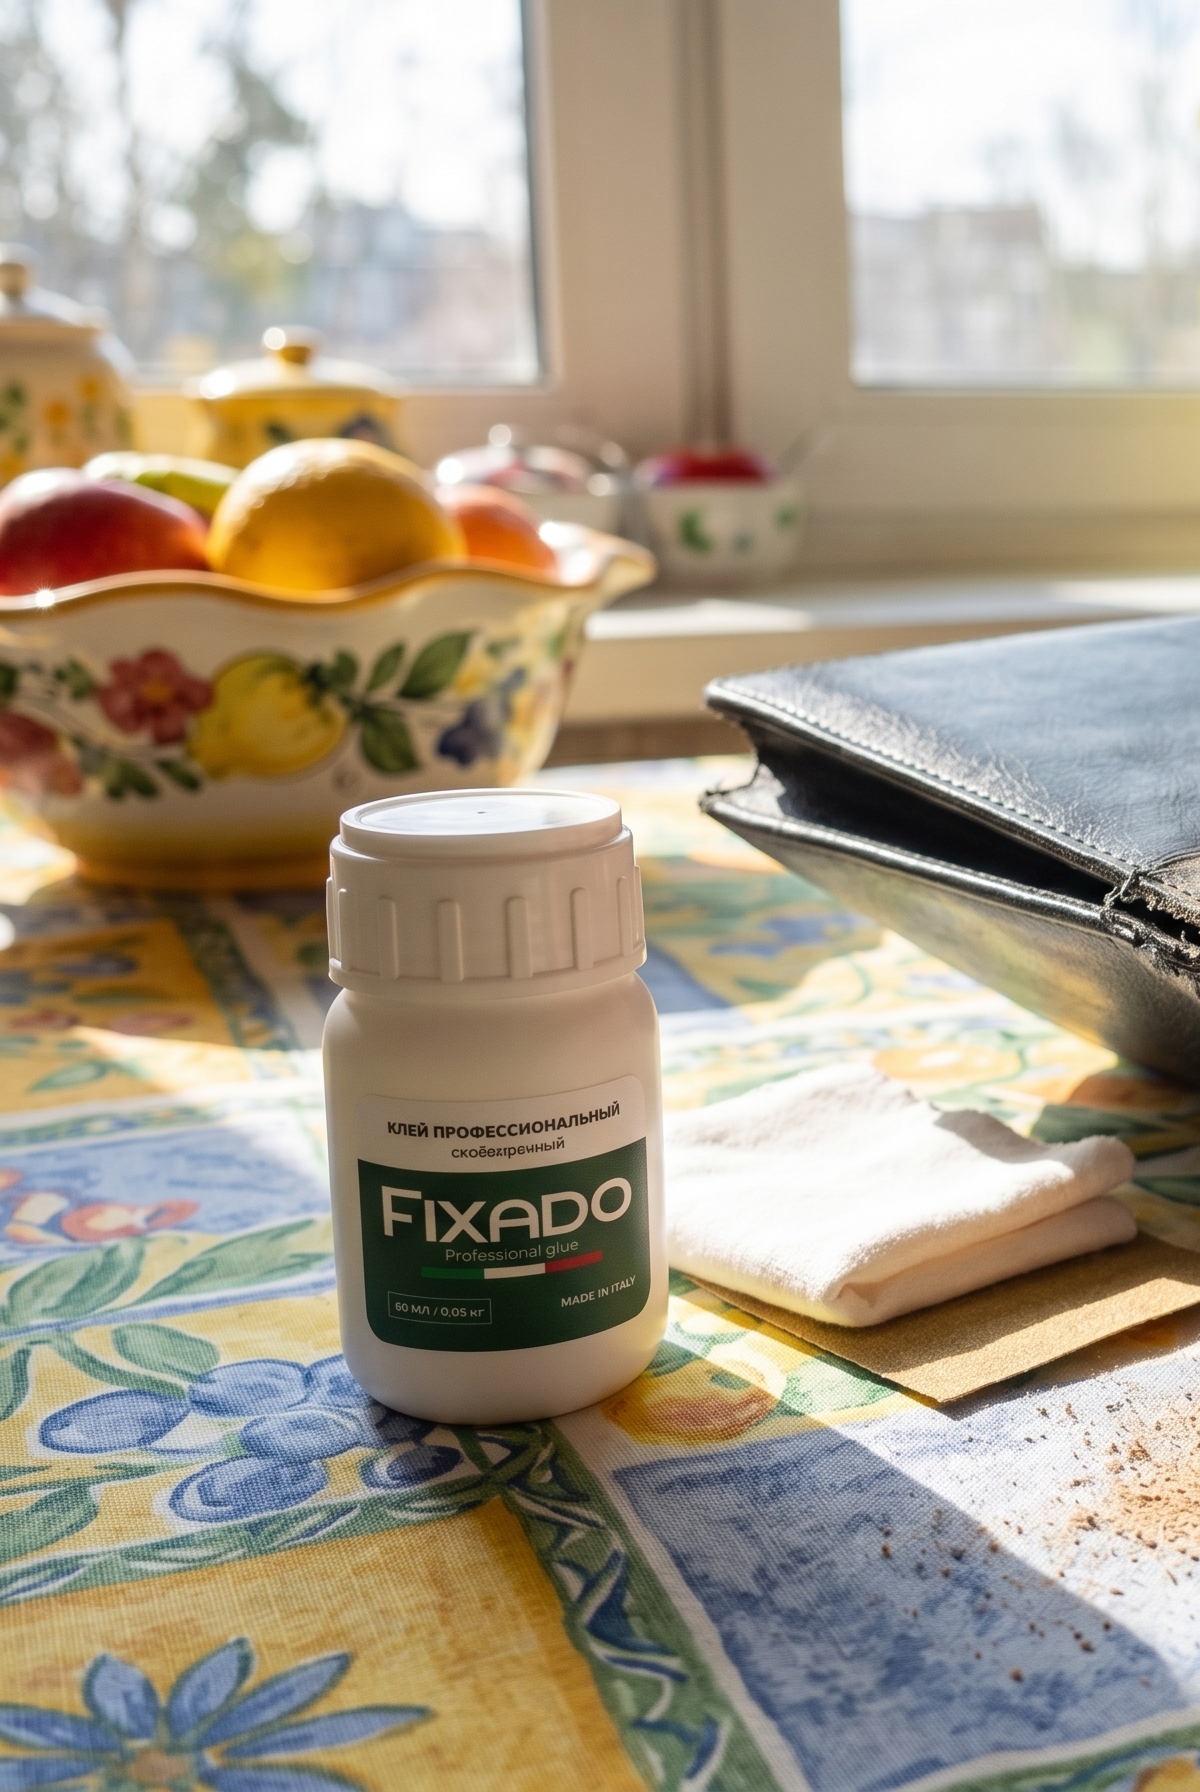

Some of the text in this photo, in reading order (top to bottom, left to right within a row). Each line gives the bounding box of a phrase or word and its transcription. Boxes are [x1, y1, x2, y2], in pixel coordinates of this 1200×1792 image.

[387, 1101, 621, 1139] КЛЕЙ ПРОФЕССИОНАЛЬНЫЙ
[445, 1241, 579, 1262] Professional glue
[560, 1275, 637, 1308] MADE IN ITALY
[395, 1302, 409, 1313] 60
[411, 1304, 431, 1316] МЛ
[440, 1307, 467, 1319] 0,05
[470, 1308, 485, 1318] кг
